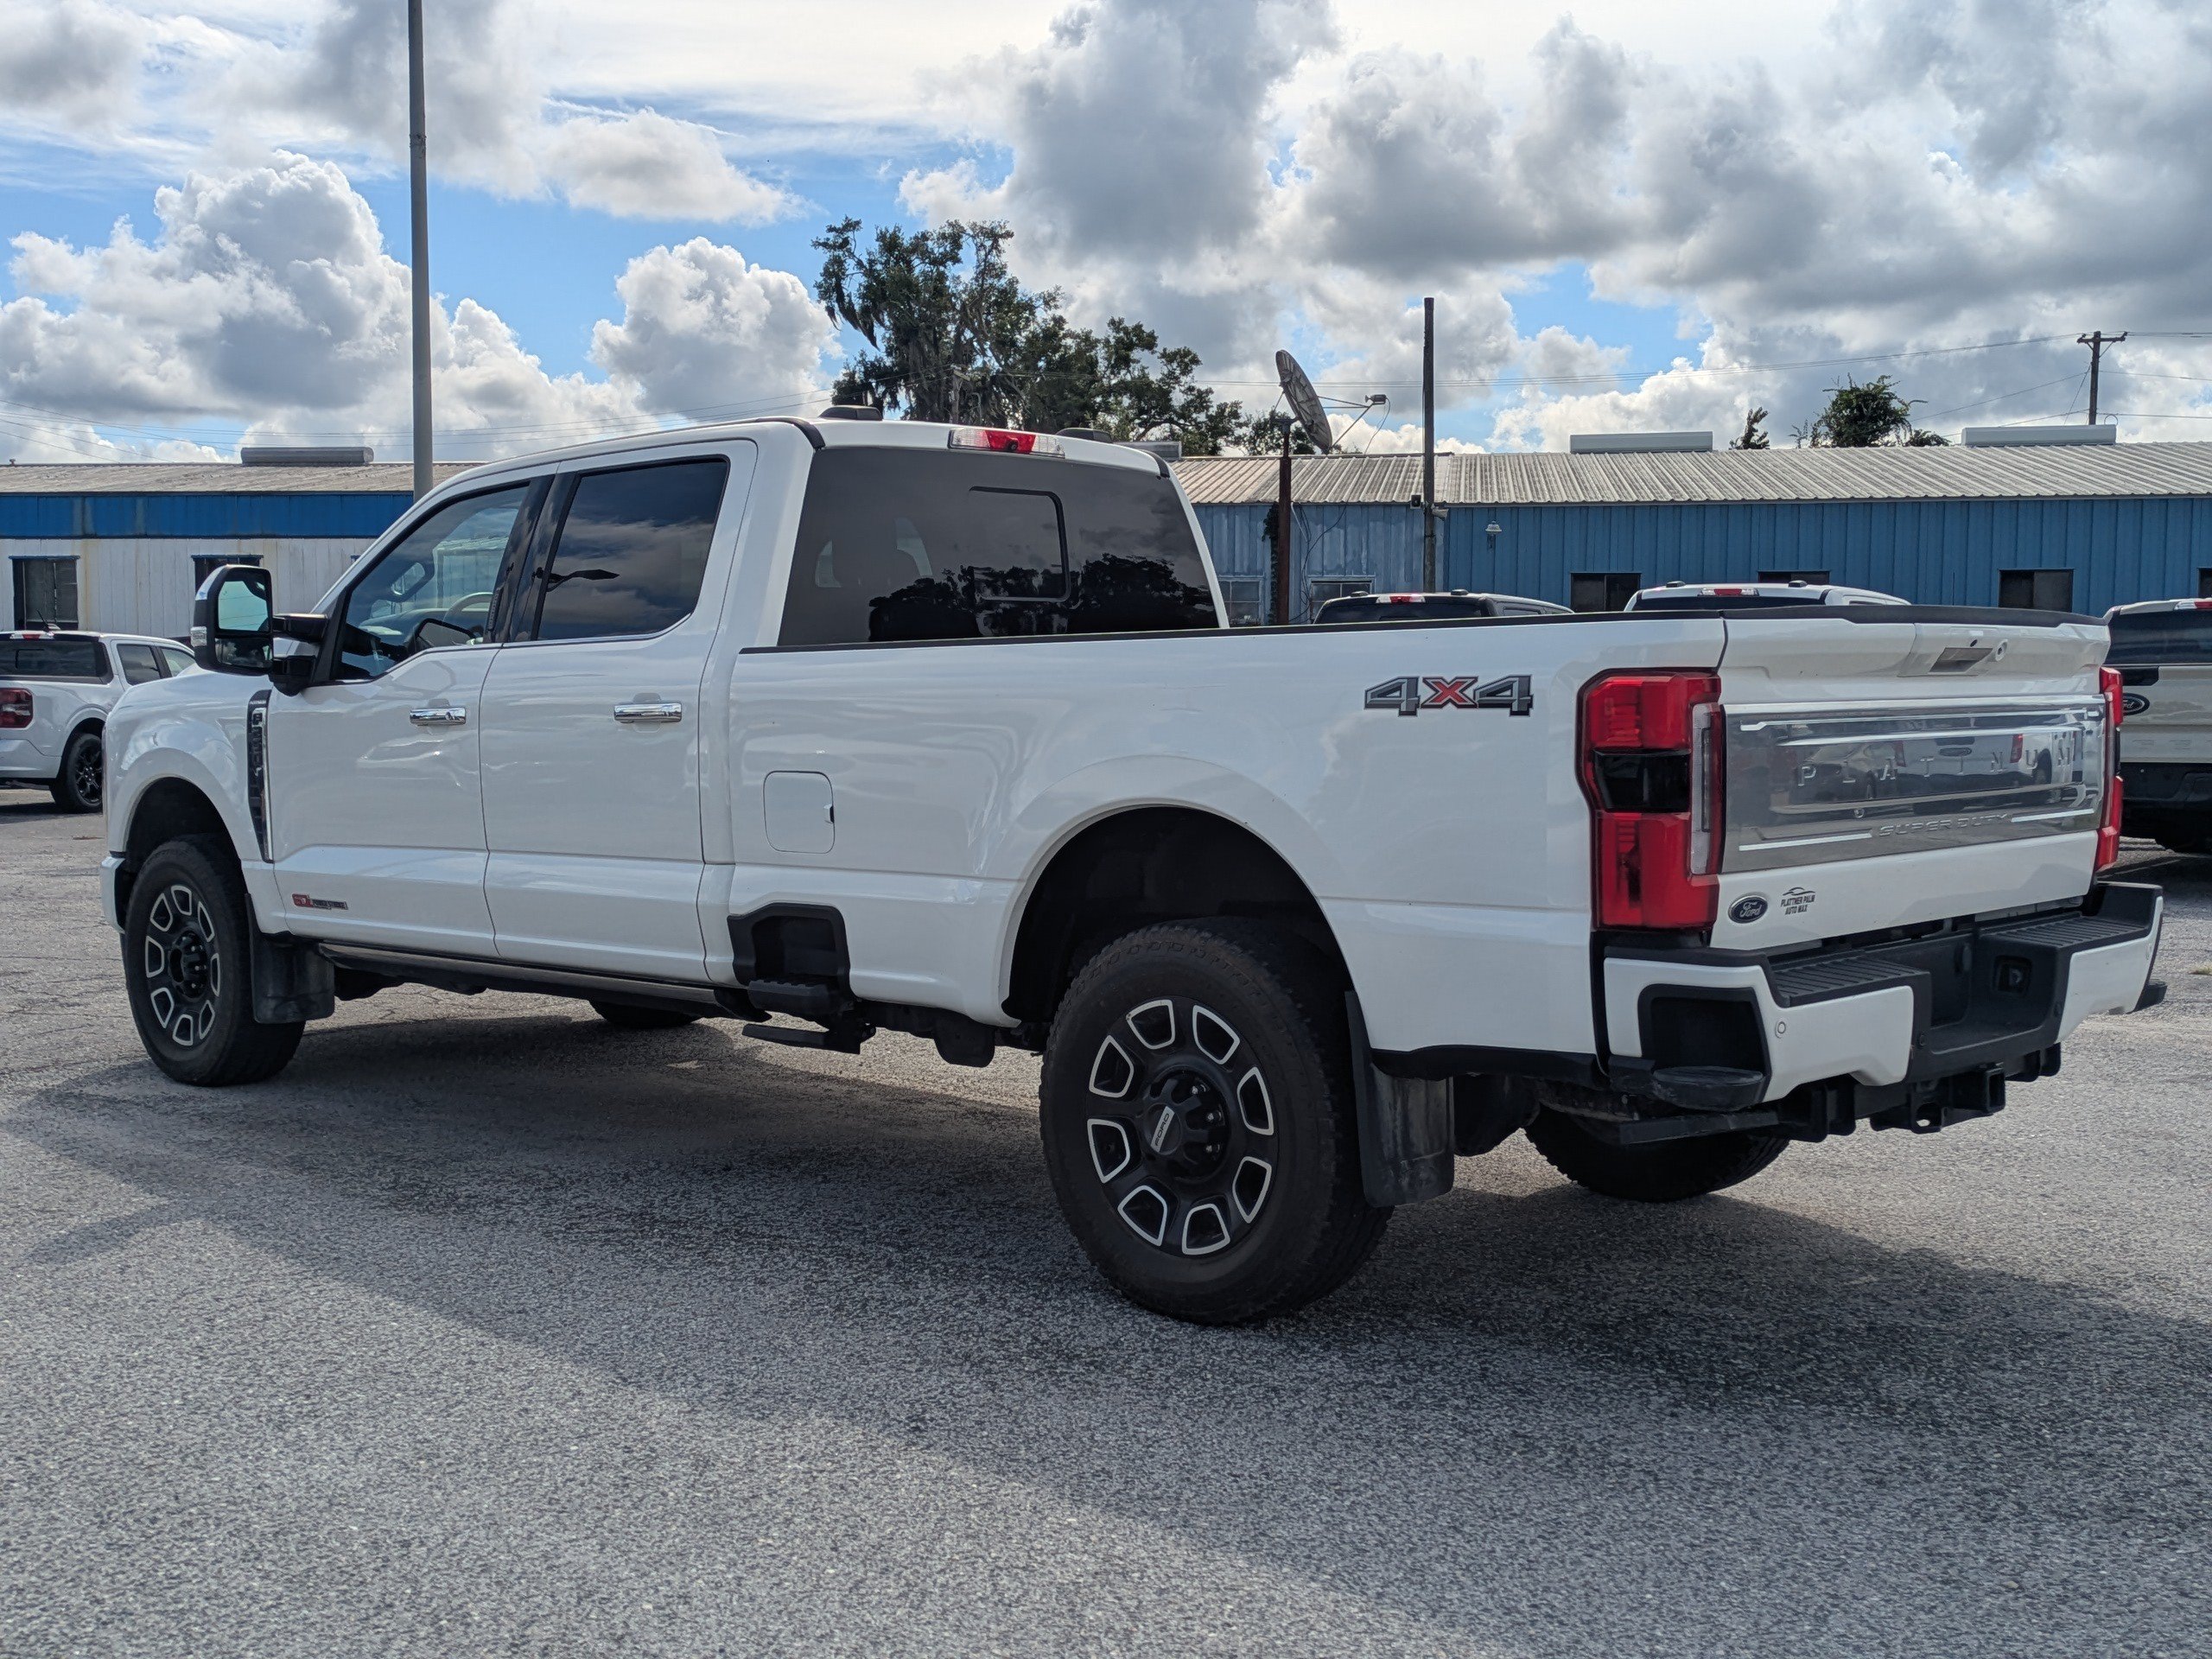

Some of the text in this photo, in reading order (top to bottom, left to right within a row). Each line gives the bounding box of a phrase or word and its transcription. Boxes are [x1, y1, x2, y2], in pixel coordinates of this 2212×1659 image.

[1798, 747, 2071, 786] PLATINUM
[1879, 820, 1951, 836] SUPER
[1957, 814, 2007, 829] DUTY
[1154, 1113, 1170, 1147] FORD
